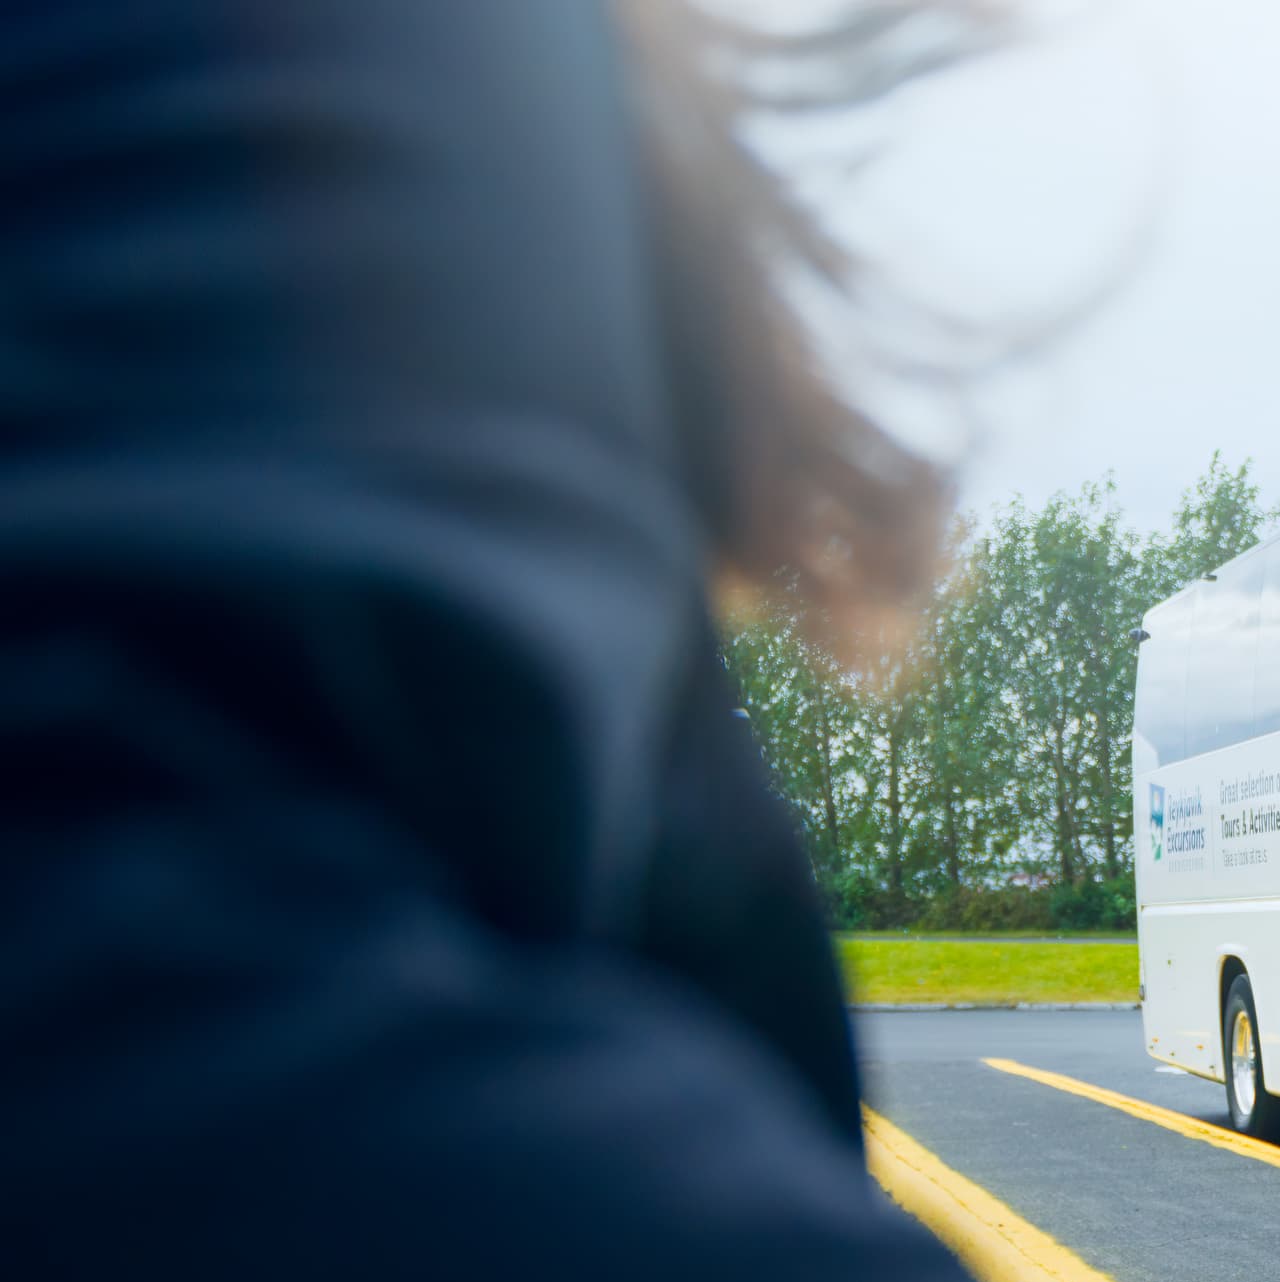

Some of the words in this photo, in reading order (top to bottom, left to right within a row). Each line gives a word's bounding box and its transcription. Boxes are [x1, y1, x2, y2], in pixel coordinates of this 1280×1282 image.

[1241, 768, 1275, 800] selection
[1221, 814, 1240, 839] Tours
[1242, 810, 1247, 835] &
[1167, 827, 1205, 854] Excursions
